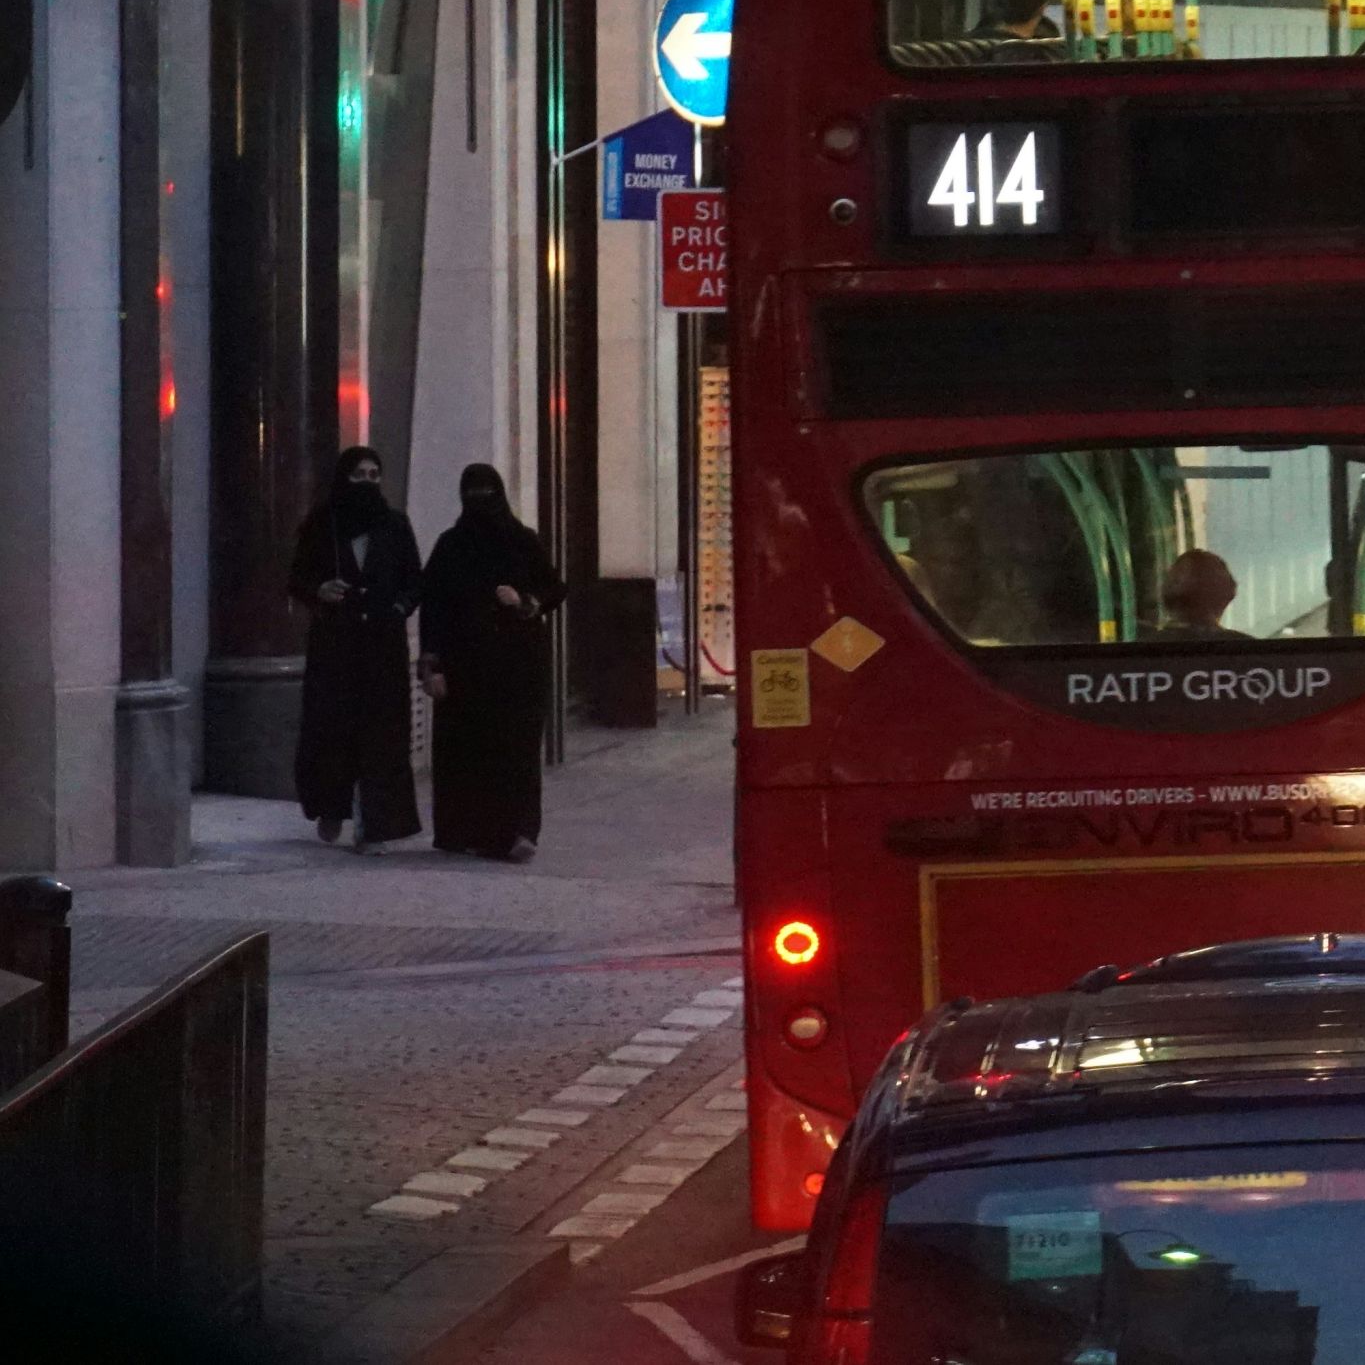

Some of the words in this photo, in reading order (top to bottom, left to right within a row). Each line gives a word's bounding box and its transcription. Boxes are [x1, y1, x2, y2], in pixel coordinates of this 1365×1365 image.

[635, 153, 677, 169] MONEY
[625, 173, 687, 188] EXCHANGE
[927, 131, 1044, 226] 414
[1067, 671, 1174, 704] RATP
[1182, 667, 1331, 705] GROUP
[971, 791, 1023, 810] WE'RE
[1025, 788, 1123, 808] RECRUITING
[1125, 786, 1195, 805] DRIVERS
